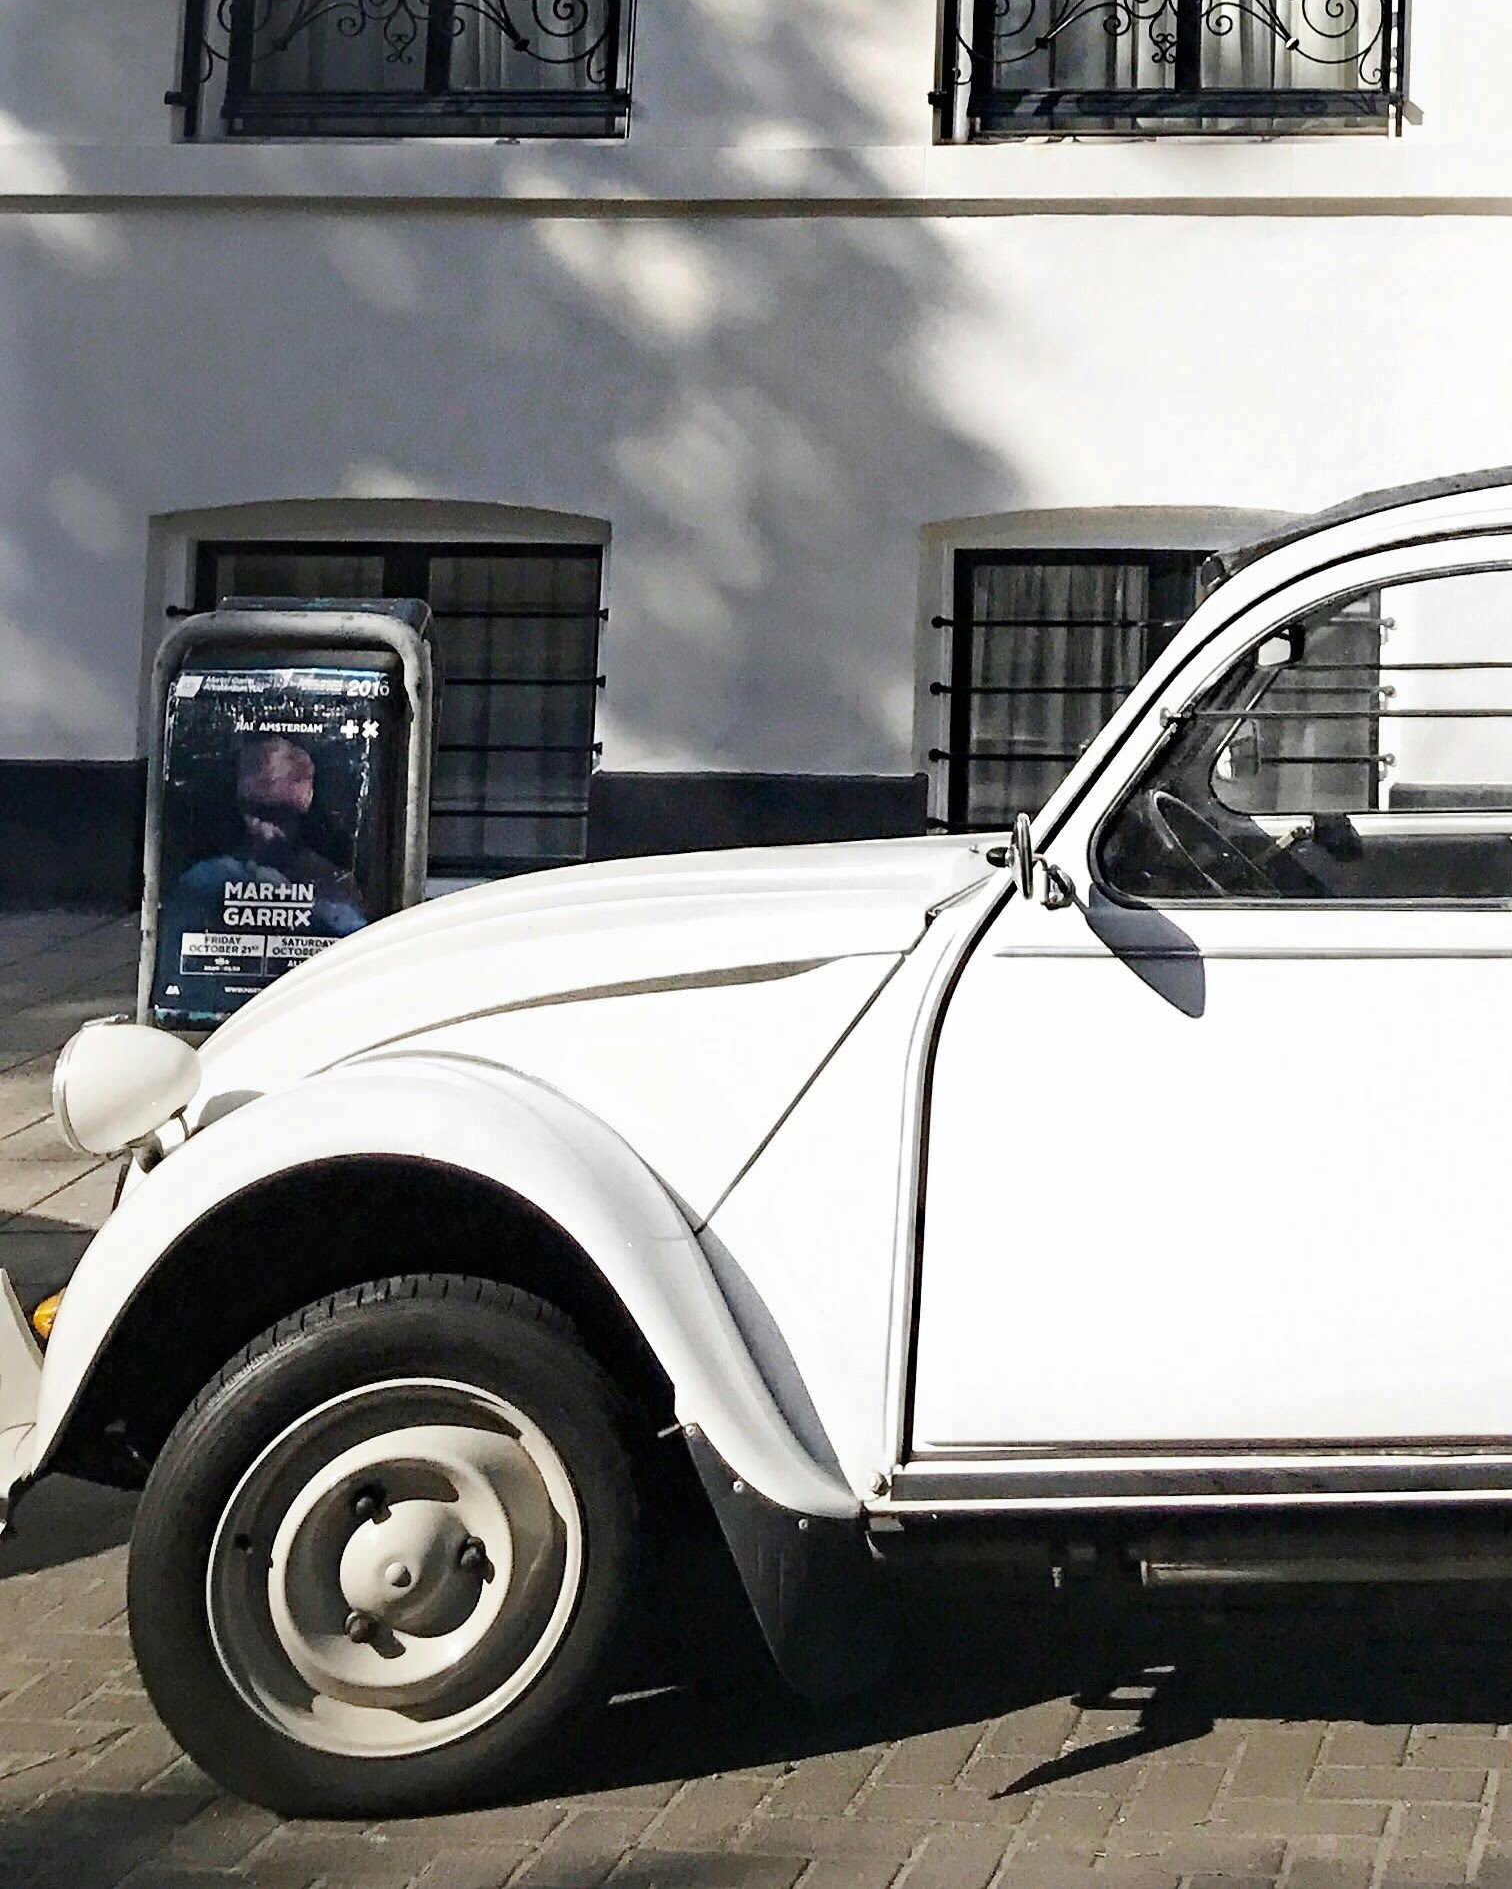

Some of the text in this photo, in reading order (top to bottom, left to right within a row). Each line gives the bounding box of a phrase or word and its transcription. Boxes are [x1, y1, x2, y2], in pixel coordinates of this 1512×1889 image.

[346, 679, 390, 698] 2016
[259, 722, 323, 734] AMSTERDAM
[223, 907, 312, 928] GARRIX
[204, 936, 242, 945] FRIDAY
[189, 944, 239, 954] OCTOBER
